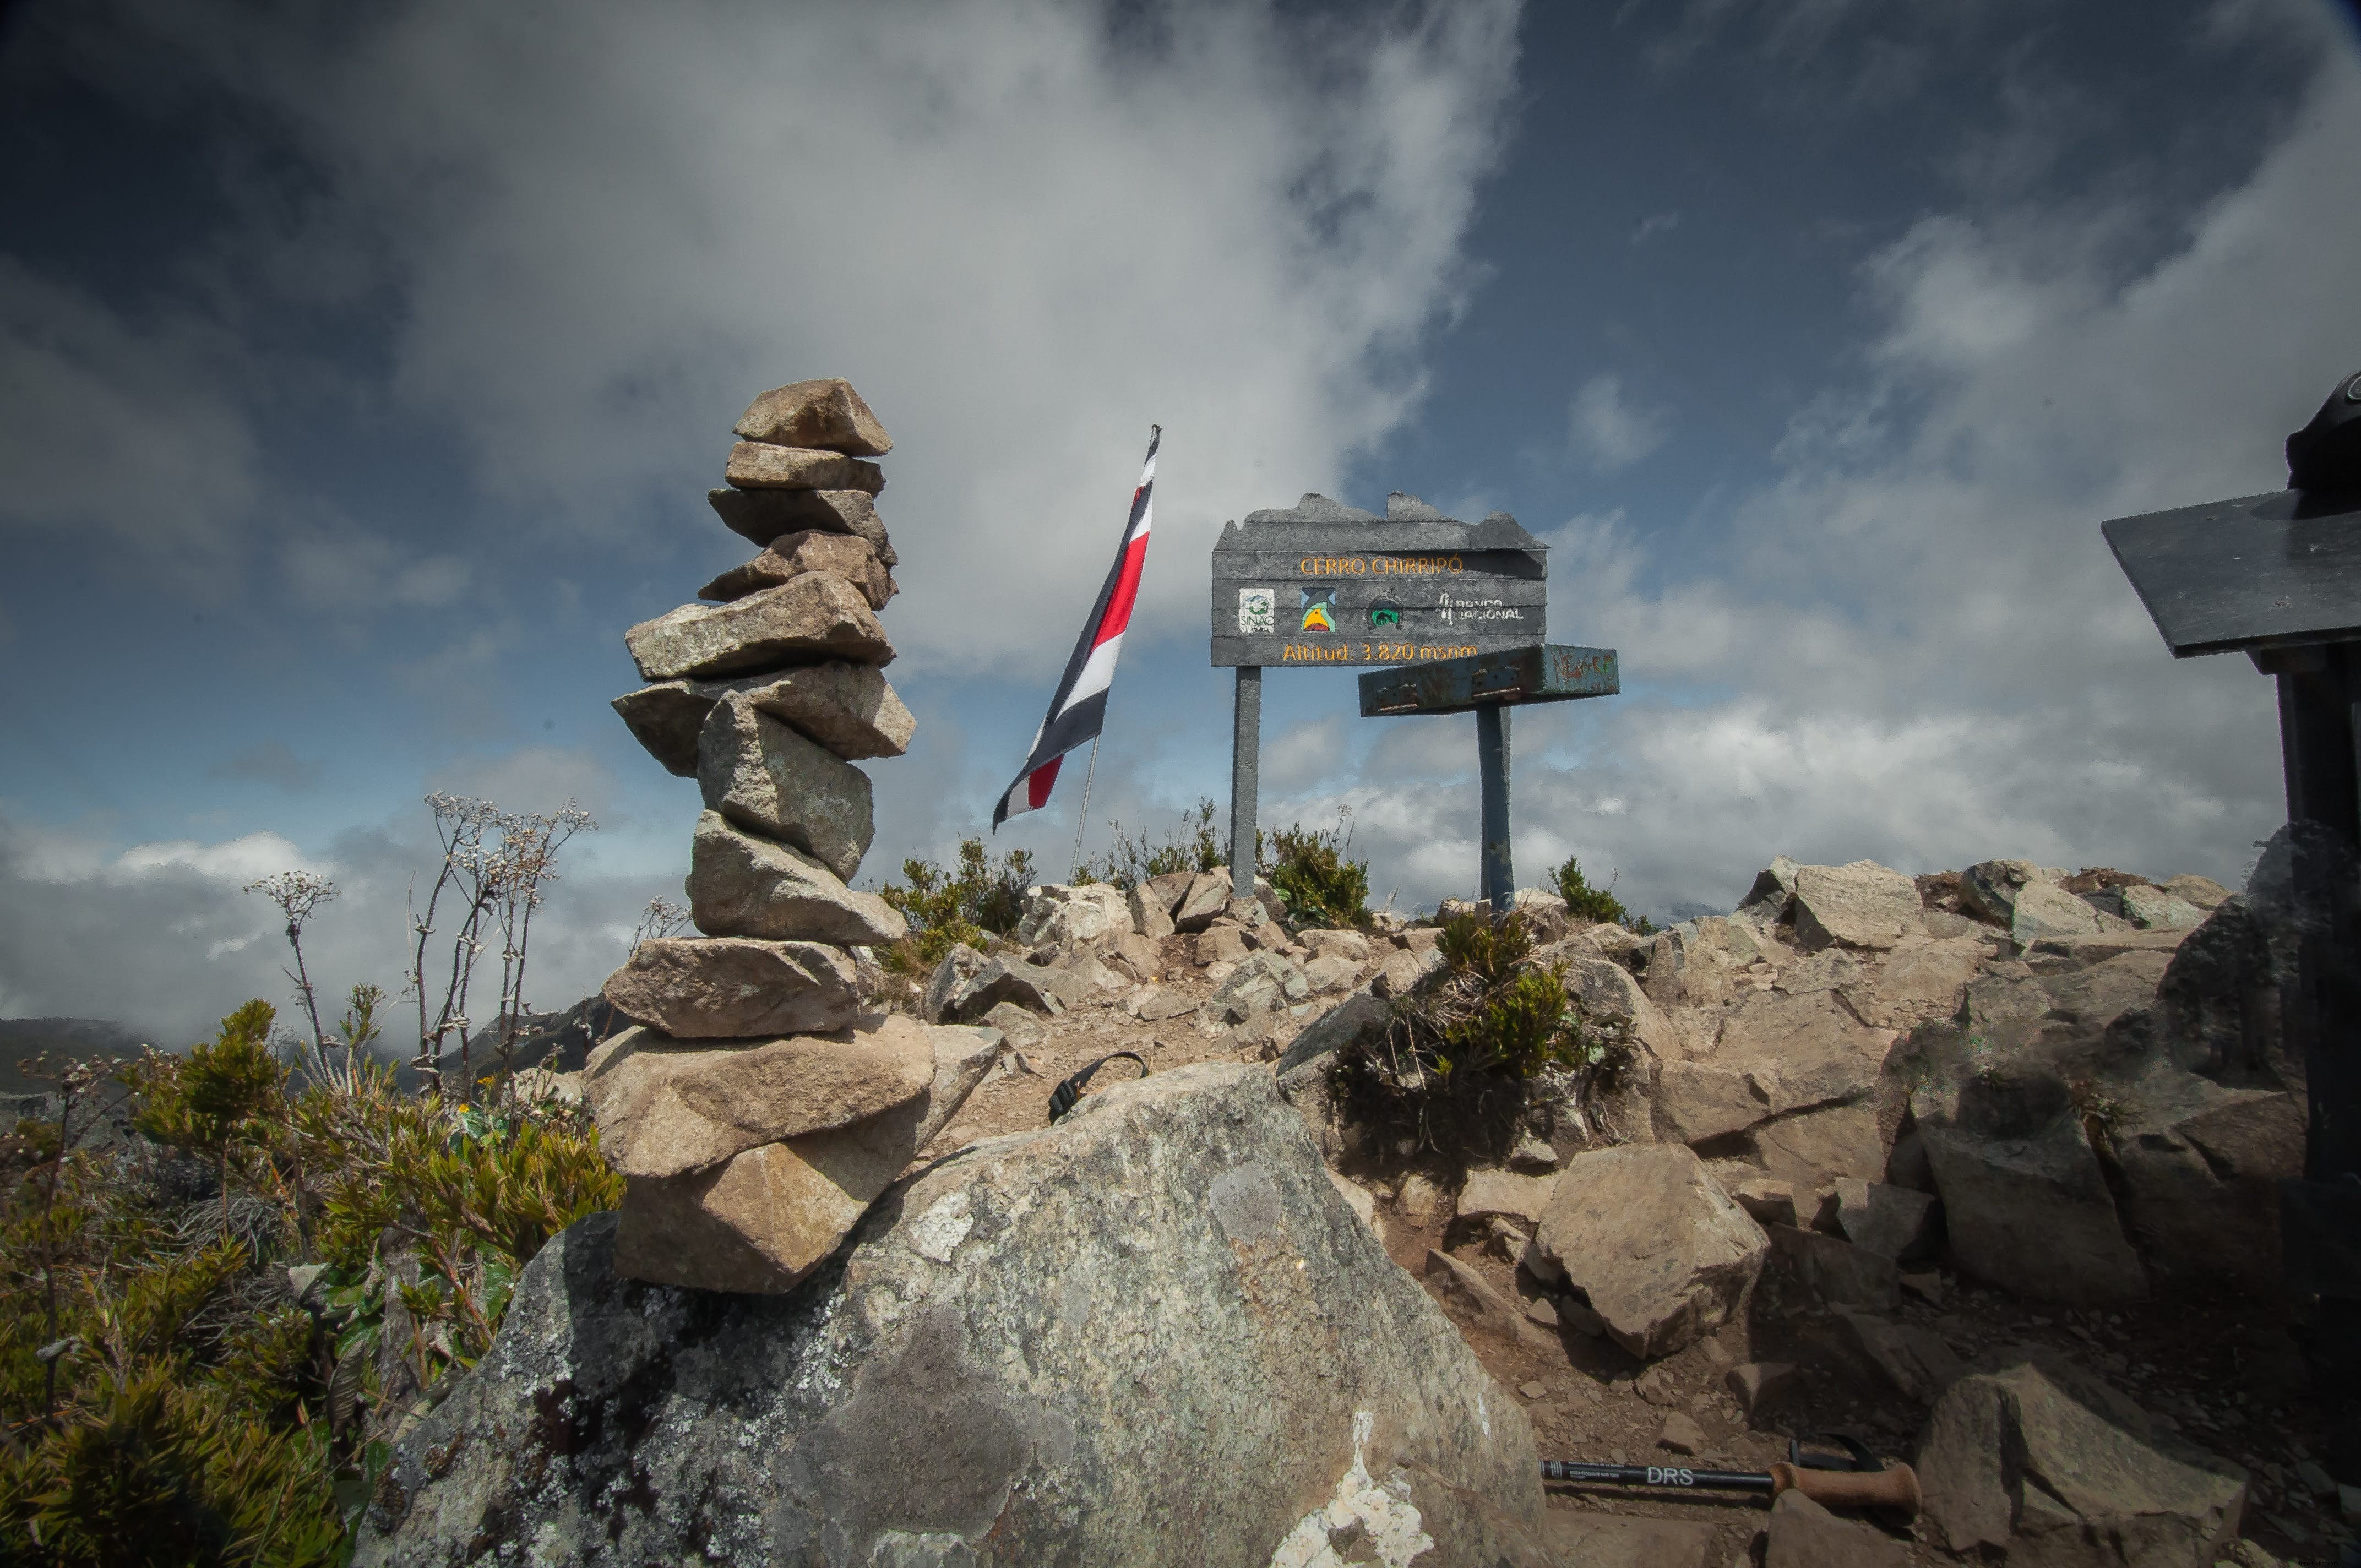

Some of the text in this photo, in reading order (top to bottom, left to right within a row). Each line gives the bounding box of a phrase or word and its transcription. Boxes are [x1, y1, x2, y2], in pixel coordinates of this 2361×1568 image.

[1300, 553, 1462, 574] CERRO CHIRRIPÓ
[1362, 642, 1415, 661] 3.820
[1419, 645, 1478, 660] msnm
[1647, 1467, 1694, 1485] DRS
